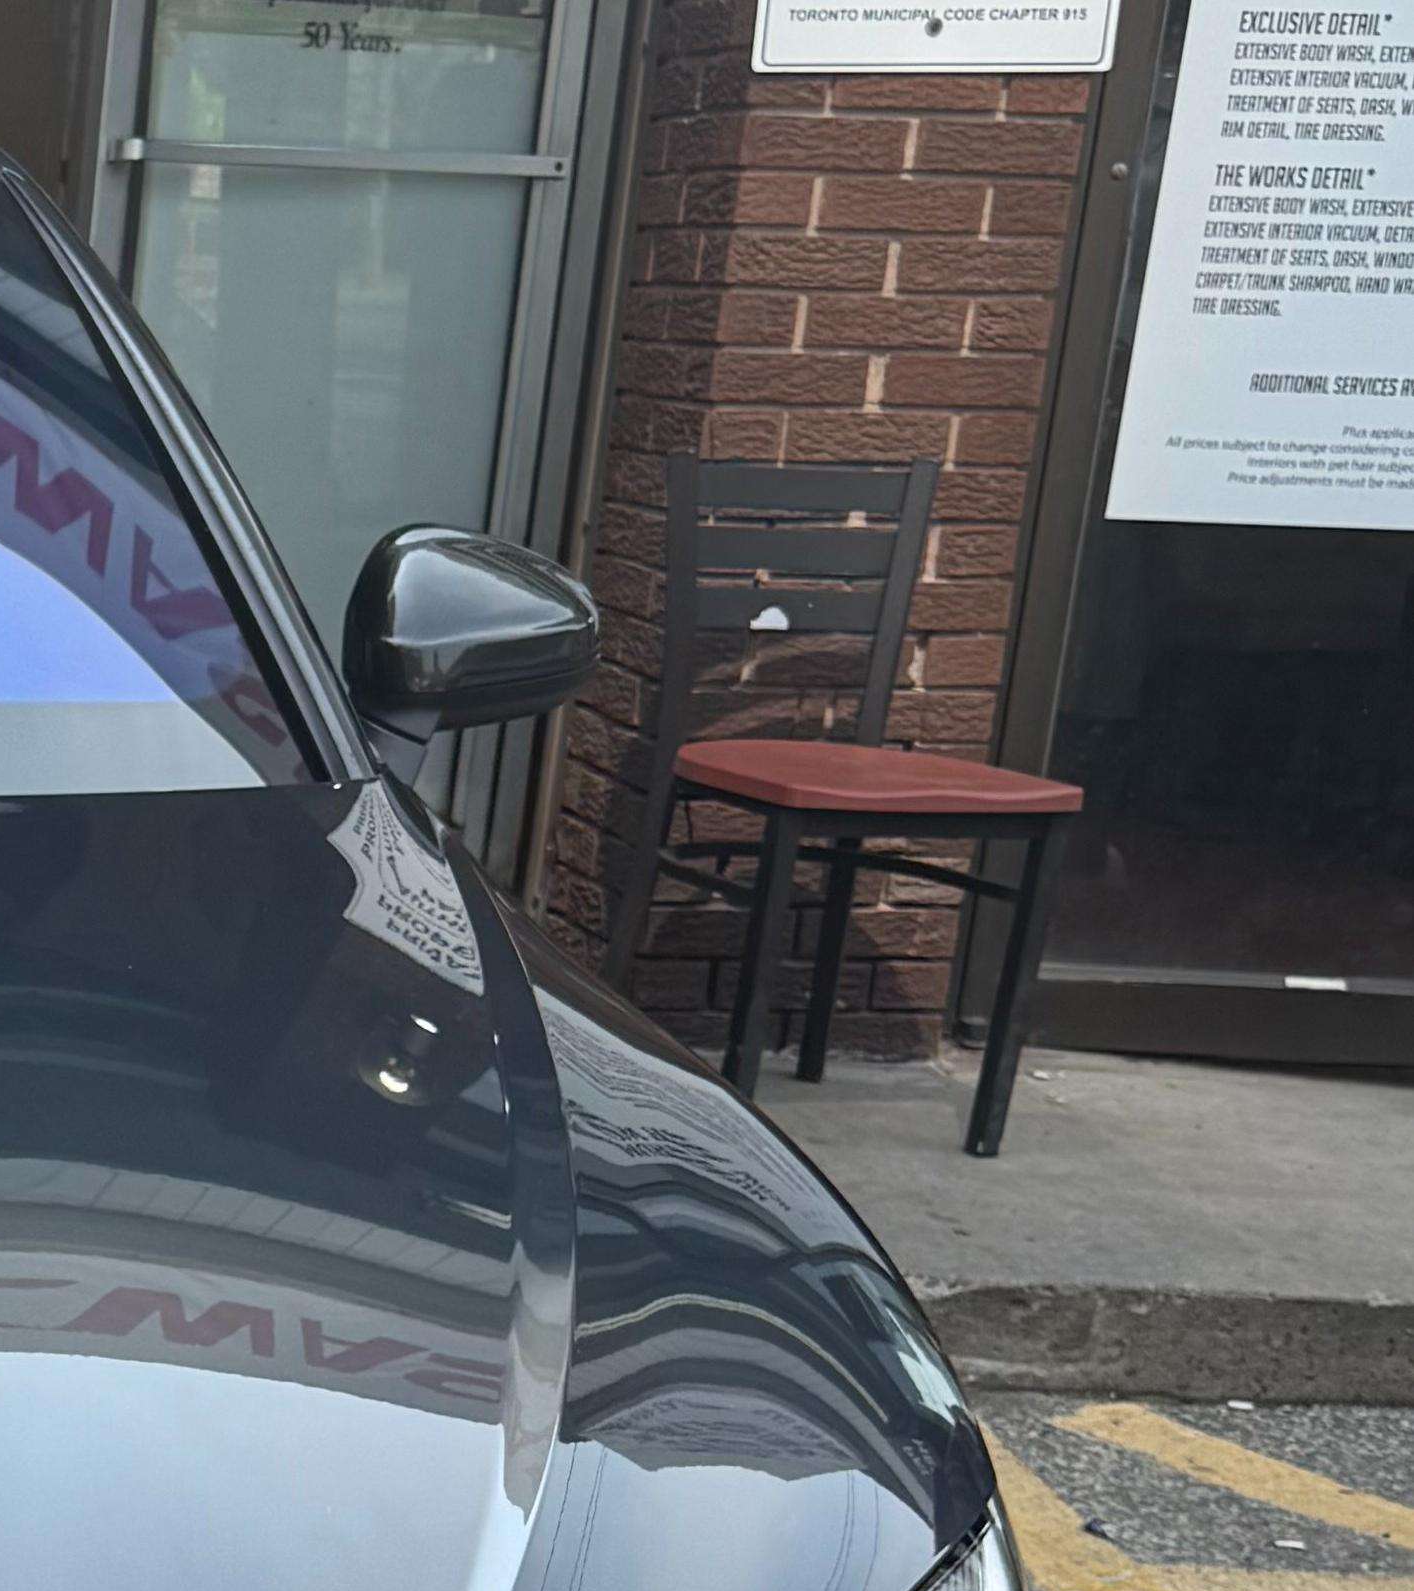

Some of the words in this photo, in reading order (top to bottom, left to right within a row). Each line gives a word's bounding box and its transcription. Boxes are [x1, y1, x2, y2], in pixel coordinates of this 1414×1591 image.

[789, 9, 858, 21] TORONTO
[861, 9, 937, 21] MUNICIPAL
[943, 8, 985, 21] CODE
[989, 8, 1060, 21] CHAPTER
[1062, 8, 1088, 21] 915
[1239, 10, 1323, 35] EXCLUSIVE
[299, 21, 331, 48] 50
[1234, 42, 1297, 61] EXTENSIVE
[1299, 43, 1332, 61] BODY
[1230, 68, 1293, 87] EXTENSIVE
[1294, 69, 1350, 89] INTERIOR
[1227, 95, 1296, 113] TREATMENT
[1221, 120, 1245, 138] RIM
[1294, 123, 1321, 140] TIRE
[1215, 164, 1245, 188] THE
[1248, 165, 1308, 189] WORKS
[1208, 195, 1271, 213] EXTENSIVE
[1273, 198, 1306, 214] BODY
[1204, 220, 1266, 239] EXTENSIVE
[1268, 222, 1323, 241] INTERIOR
[1201, 246, 1270, 265] TREATMENT
[1355, 276, 1391, 294] HAND
[1192, 297, 1217, 315] TIRE
[1249, 373, 1330, 395] ADDITIONAL
[1333, 376, 1399, 397] SERVICES
